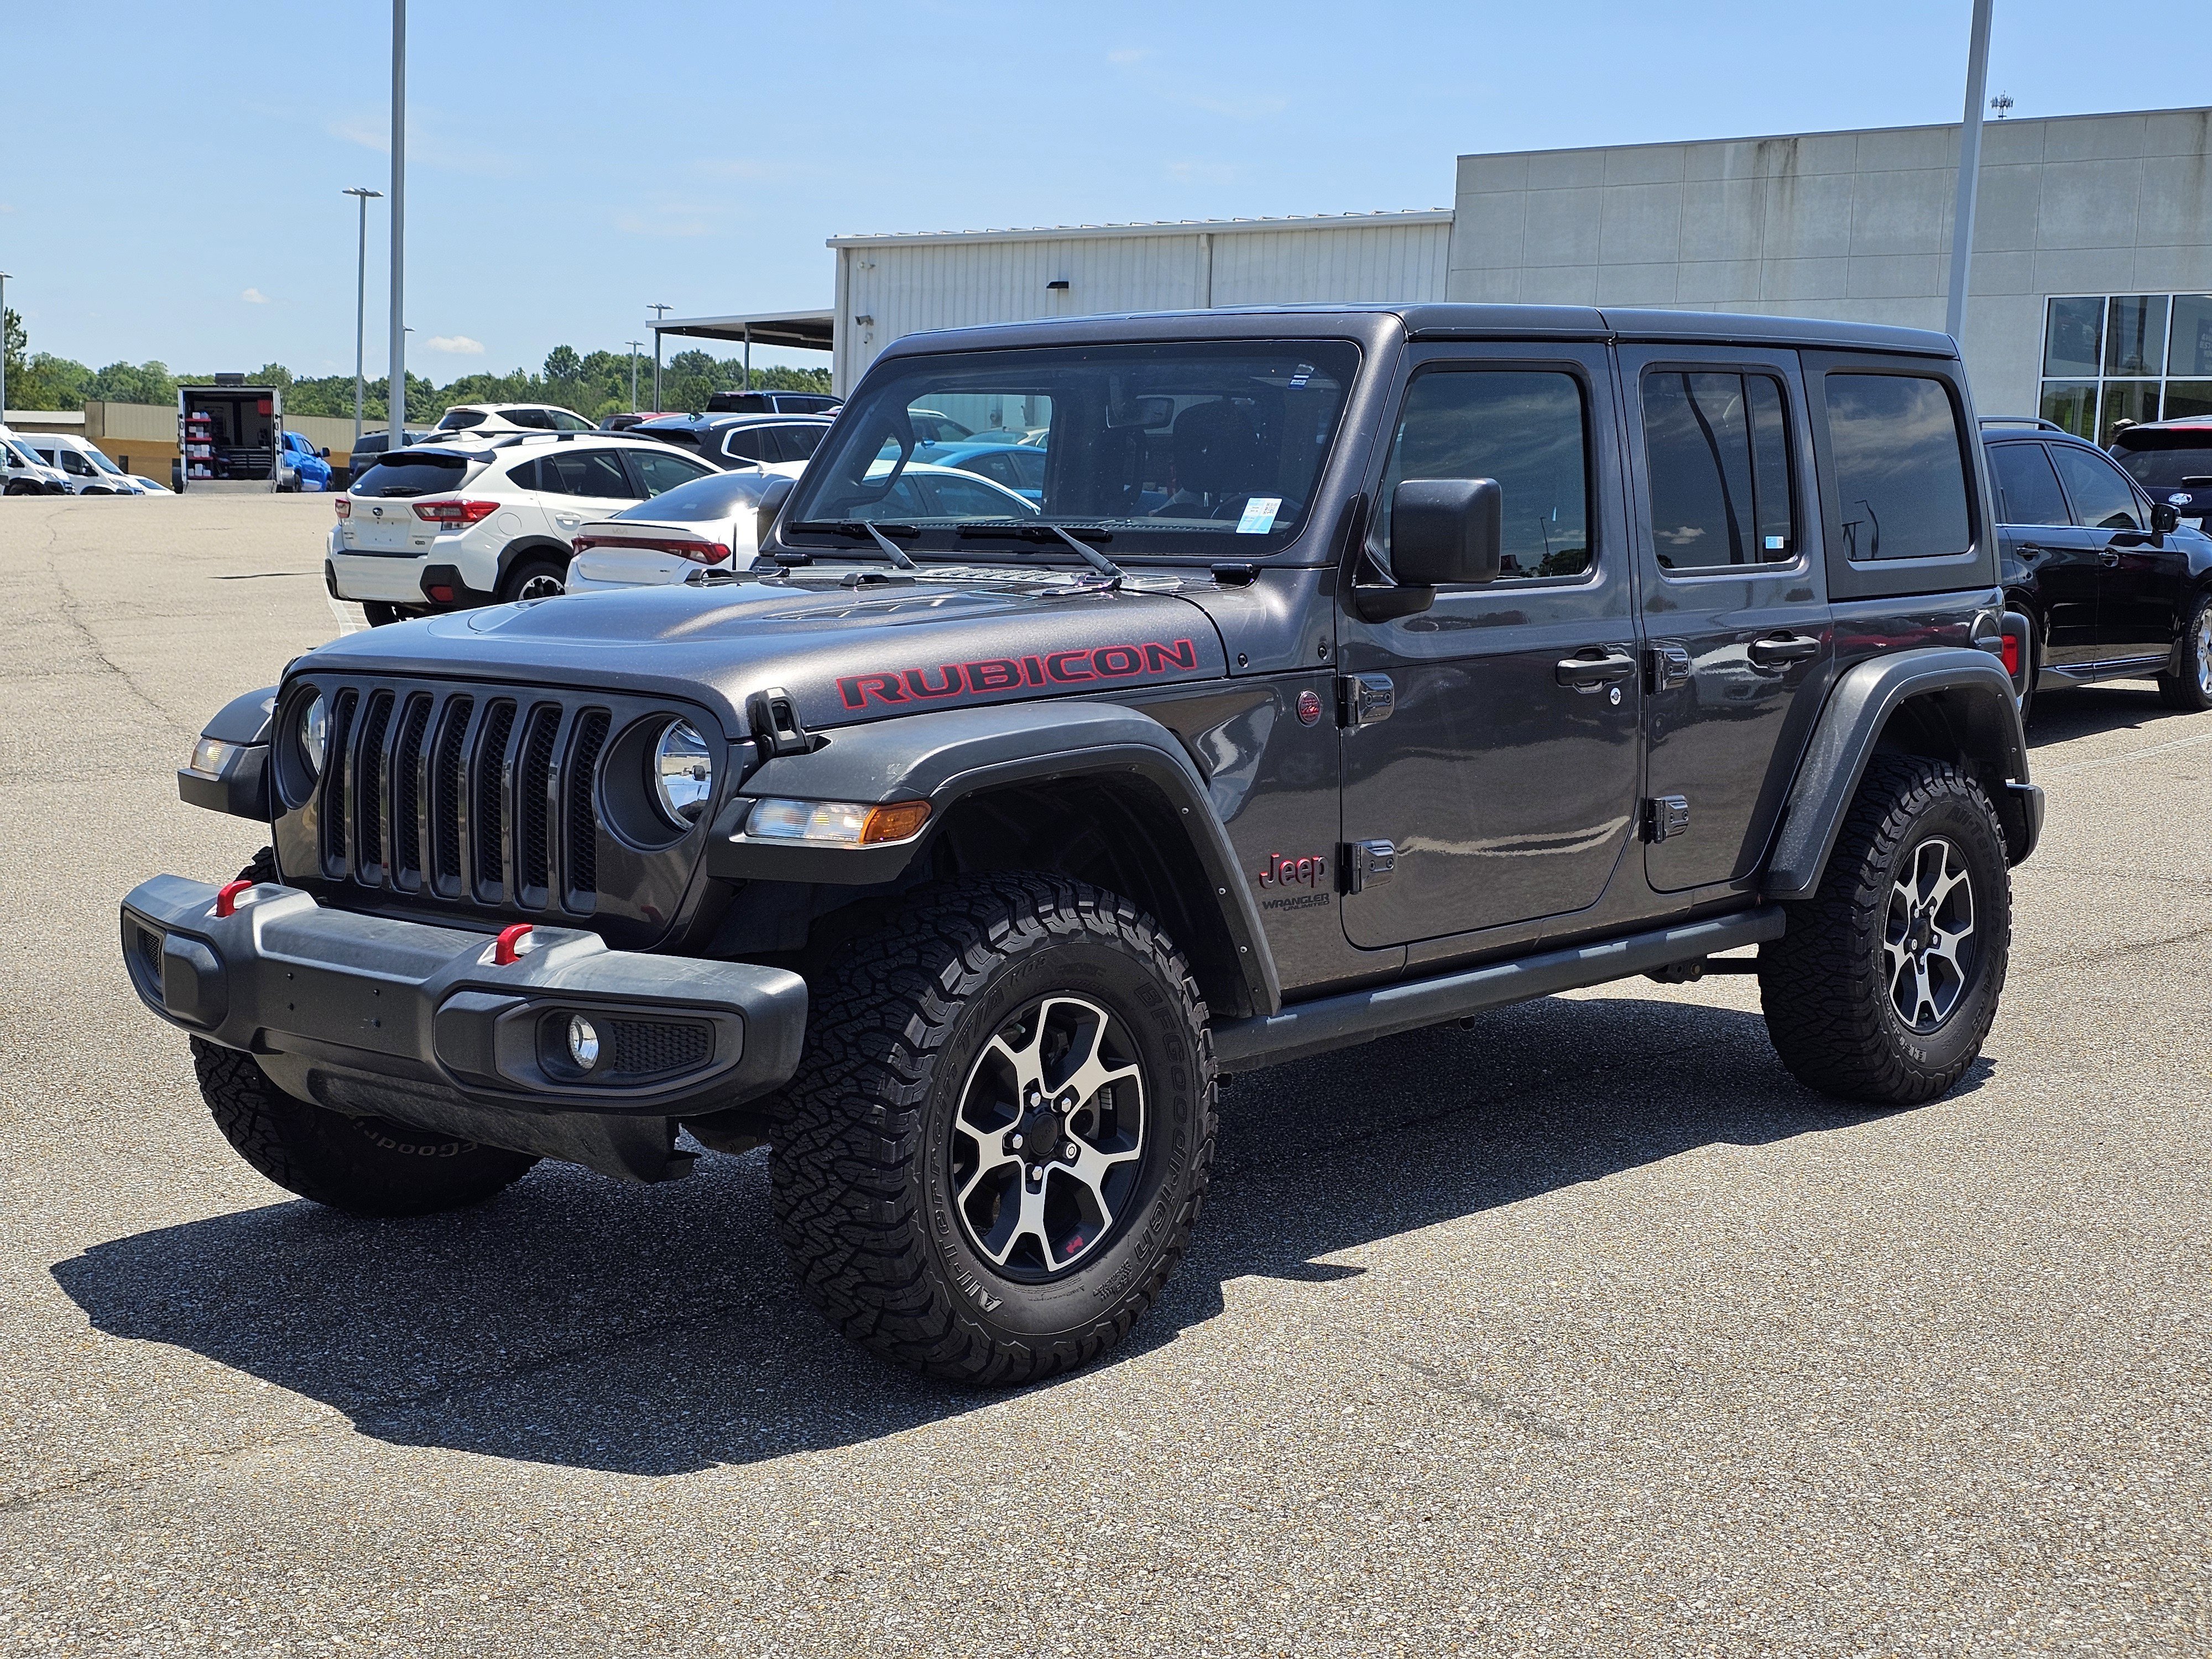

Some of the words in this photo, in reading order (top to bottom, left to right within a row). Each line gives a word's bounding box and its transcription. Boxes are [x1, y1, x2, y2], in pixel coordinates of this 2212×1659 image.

[836, 639, 1197, 710] RUBICON
[1259, 852, 1327, 889] Jeep
[1261, 892, 1329, 910] WRANGLER
[1283, 900, 1329, 911] UNLIMITED
[931, 1062, 1004, 1312] All-Terrain
